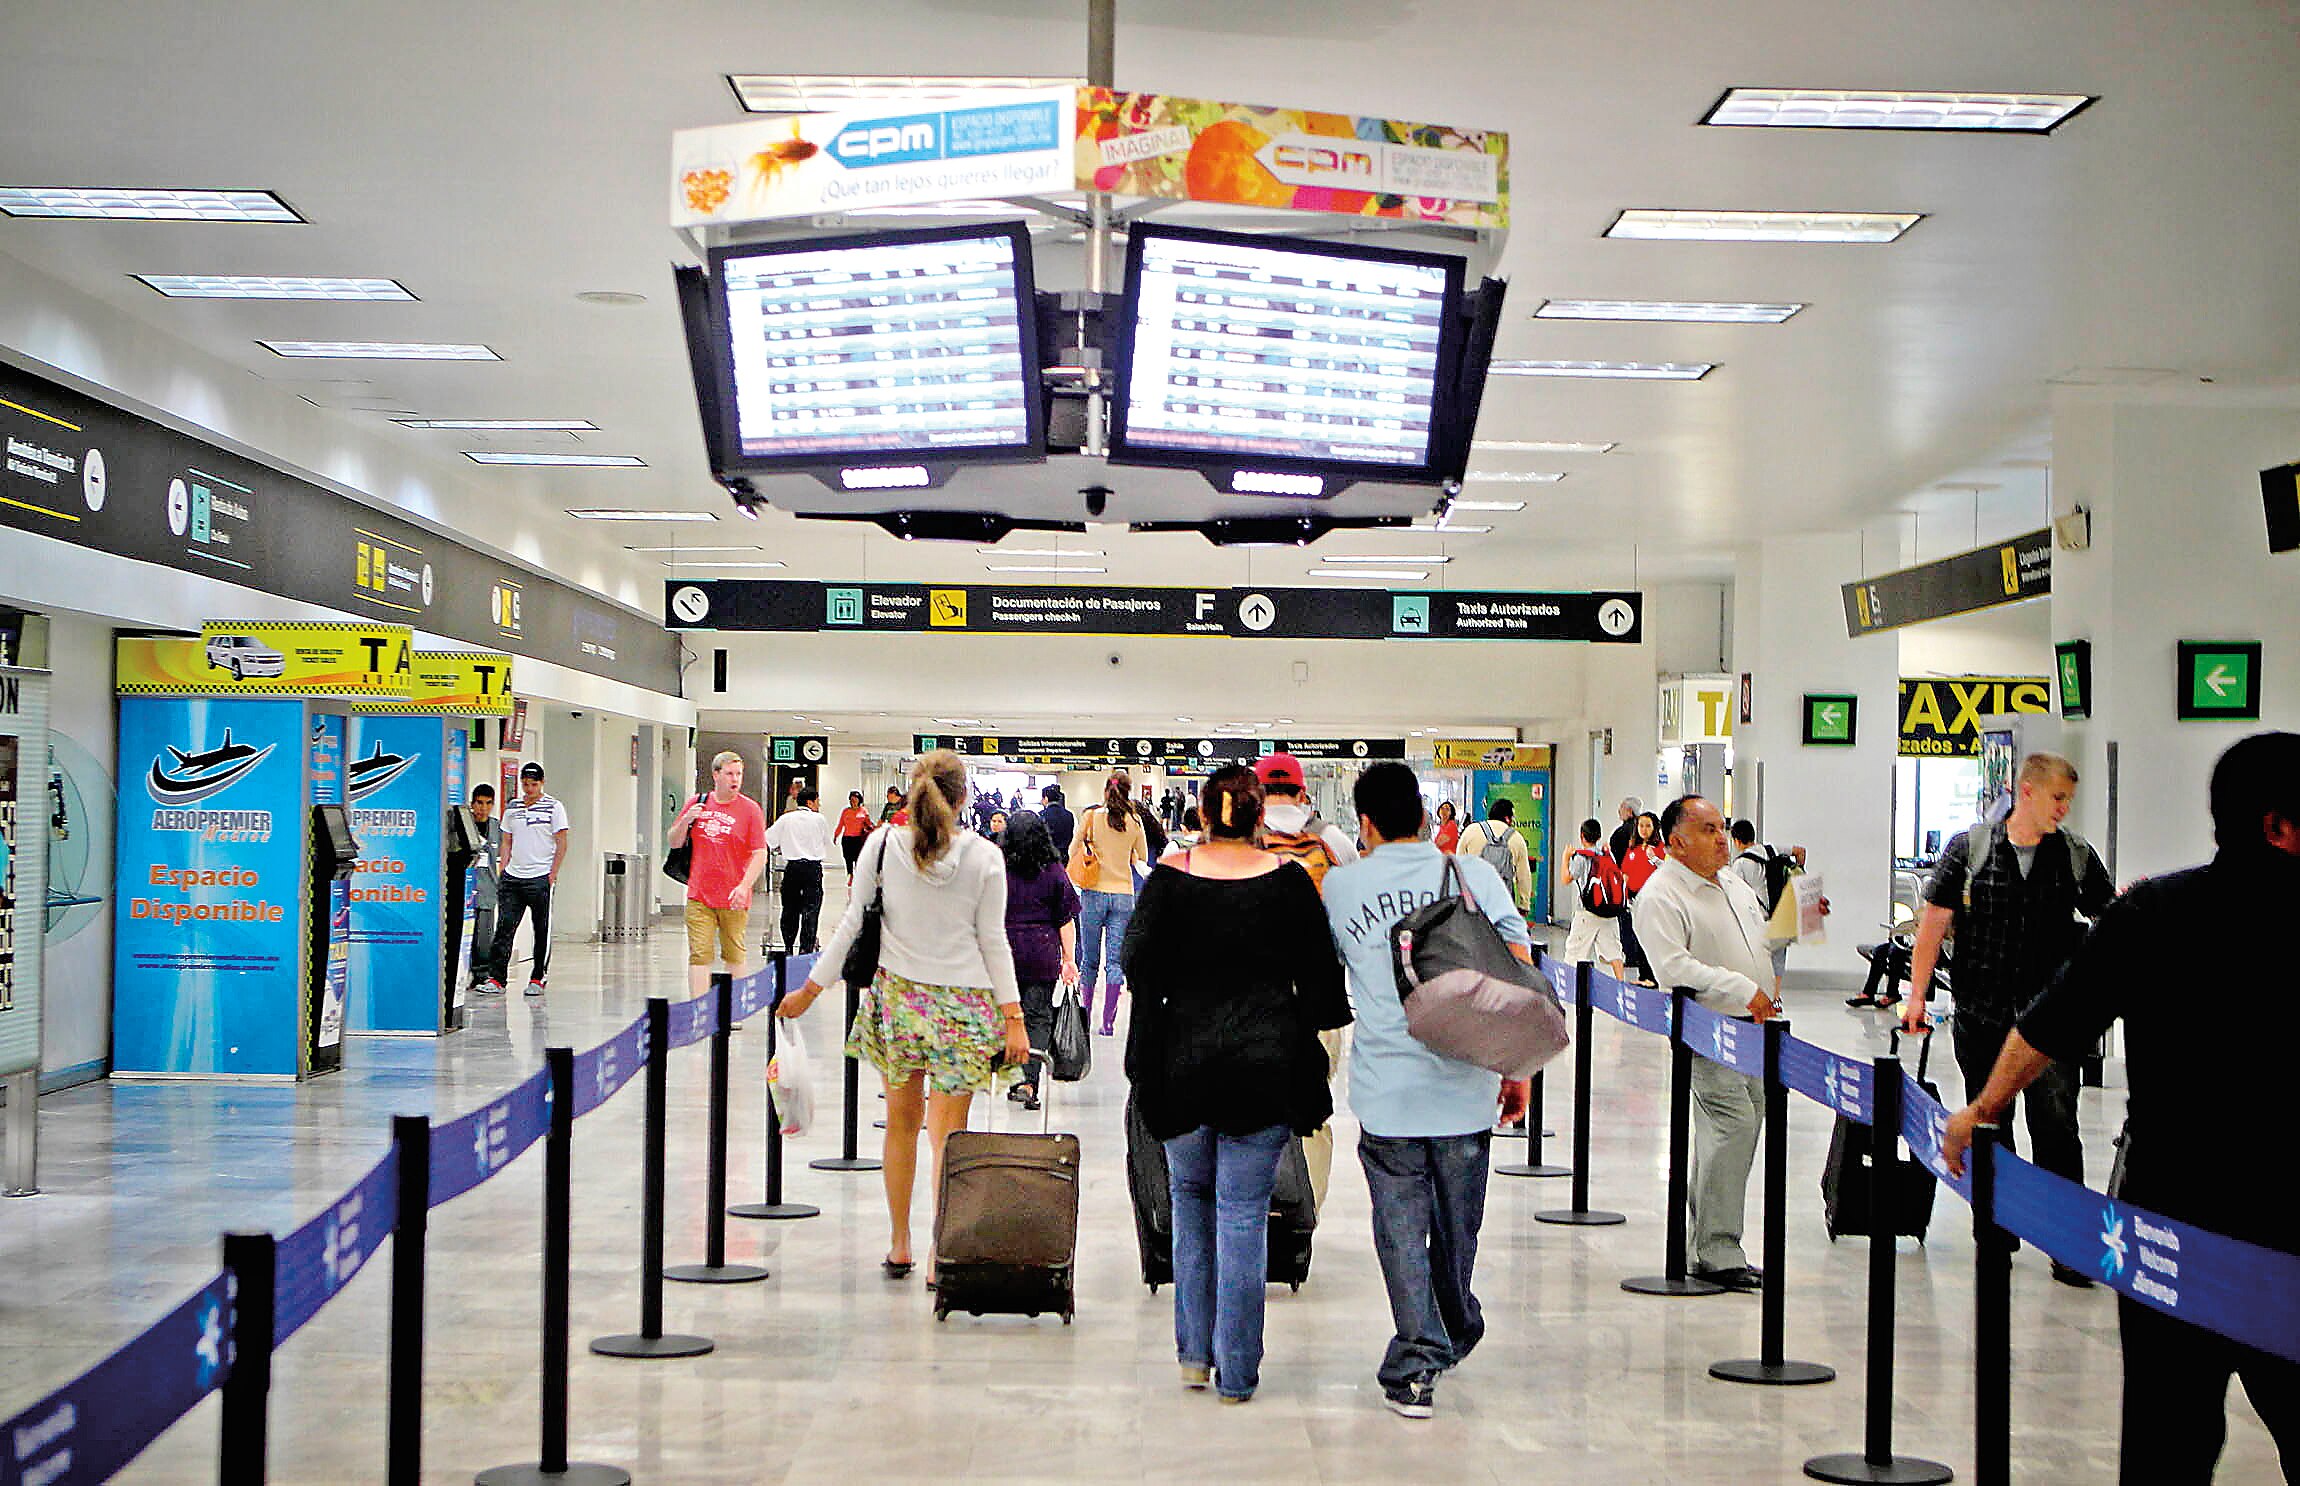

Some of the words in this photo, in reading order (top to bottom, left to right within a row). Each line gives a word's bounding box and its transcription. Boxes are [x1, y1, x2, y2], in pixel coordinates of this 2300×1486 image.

[838, 123, 934, 158] cpm
[1274, 145, 1373, 177] cpm
[865, 178, 890, 195] tan
[895, 174, 933, 195] lejos
[938, 168, 999, 190] quieres
[1003, 158, 1060, 184] llegar?
[871, 594, 923, 607] Elevador
[992, 595, 1084, 610] Documentación
[1085, 599, 1101, 610] de
[1102, 597, 1161, 613] Pasajeros
[1195, 593, 1216, 620] F
[1456, 602, 1488, 615] Taxis
[1489, 602, 1560, 616] Autorizados
[871, 608, 908, 619] Elevator
[1456, 617, 1503, 628] Authorized
[1504, 618, 1528, 629] Taxis
[1898, 682, 2050, 734] AXIS
[1108, 739, 1120, 752] G
[152, 809, 272, 832] AEROPREMIER
[149, 863, 260, 892] Espacio
[129, 897, 284, 926] Disponible
